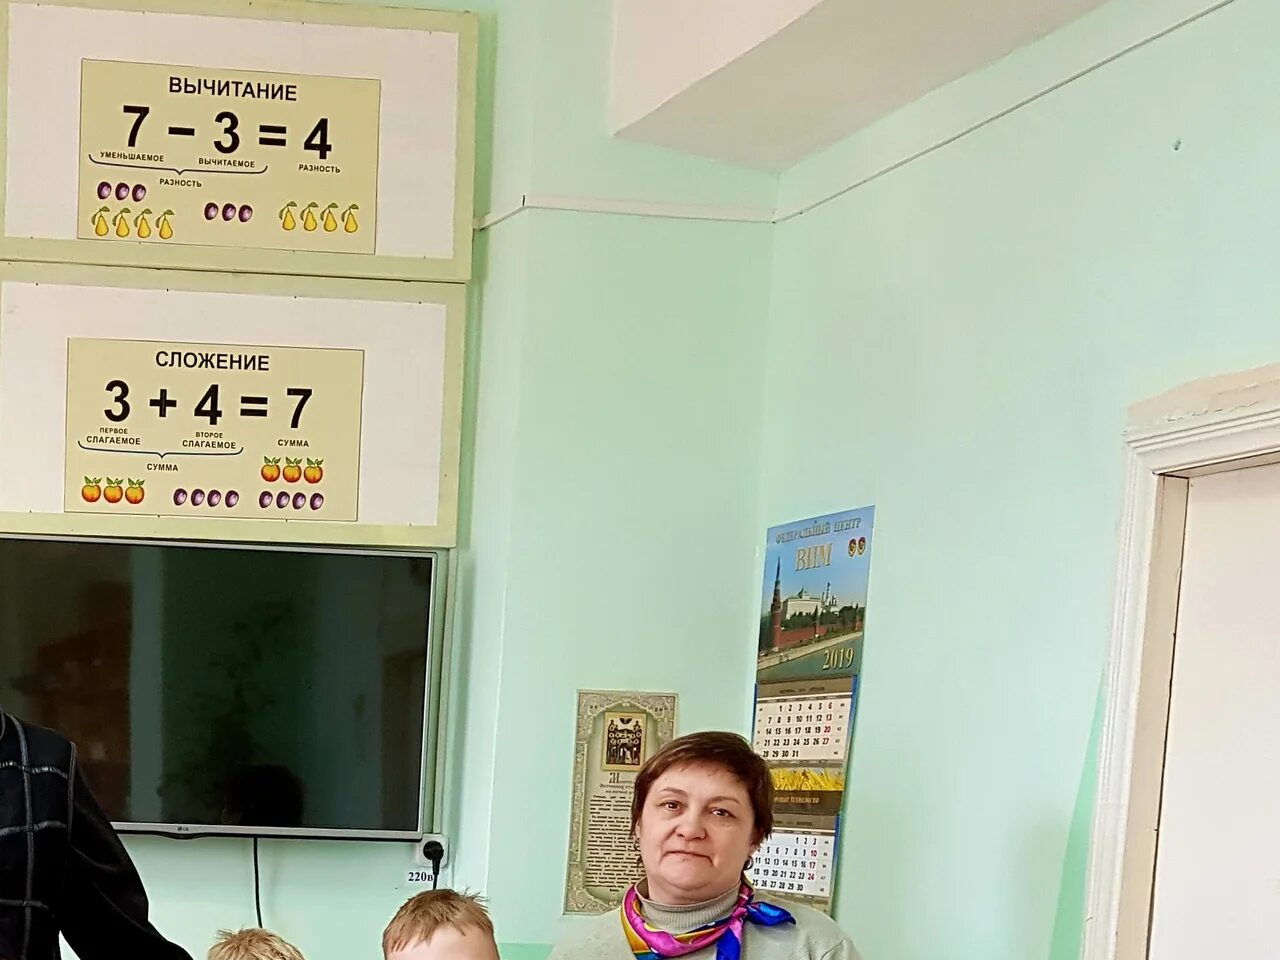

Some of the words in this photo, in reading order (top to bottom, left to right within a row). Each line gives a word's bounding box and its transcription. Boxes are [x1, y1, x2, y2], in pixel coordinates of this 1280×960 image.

[169, 76, 297, 101] ВЫЧИТАНИЕ
[123, 105, 149, 147] 7
[214, 111, 239, 153] 3
[304, 118, 332, 160] 4
[100, 151, 164, 162] УМЕНЬШАЕМОЕ
[199, 158, 255, 168] ВЫЧИТАЕМОЕ
[299, 164, 340, 173] РАЗНОСТЬ
[160, 178, 202, 188] РАЗНОСТЬ
[156, 351, 269, 371] СЛОЖЕНИЕ
[104, 380, 130, 422] 3
[194, 384, 222, 425] 4
[286, 388, 313, 428] 7
[100, 427, 128, 435] ПЕРВОЕ
[86, 436, 141, 445] СЛАГАЕМОЕ
[182, 440, 236, 449] СЛАГАЕМОЕ
[278, 439, 309, 447] СУММА
[147, 463, 178, 471] СУММА
[823, 648, 853, 670] 2019
[816, 714, 822, 722] 12
[793, 738, 800, 746] 24
[822, 737, 829, 745] 27
[780, 870, 787, 878] 21
[789, 871, 796, 879] 22
[779, 881, 785, 889] 28
[787, 882, 794, 890] 29
